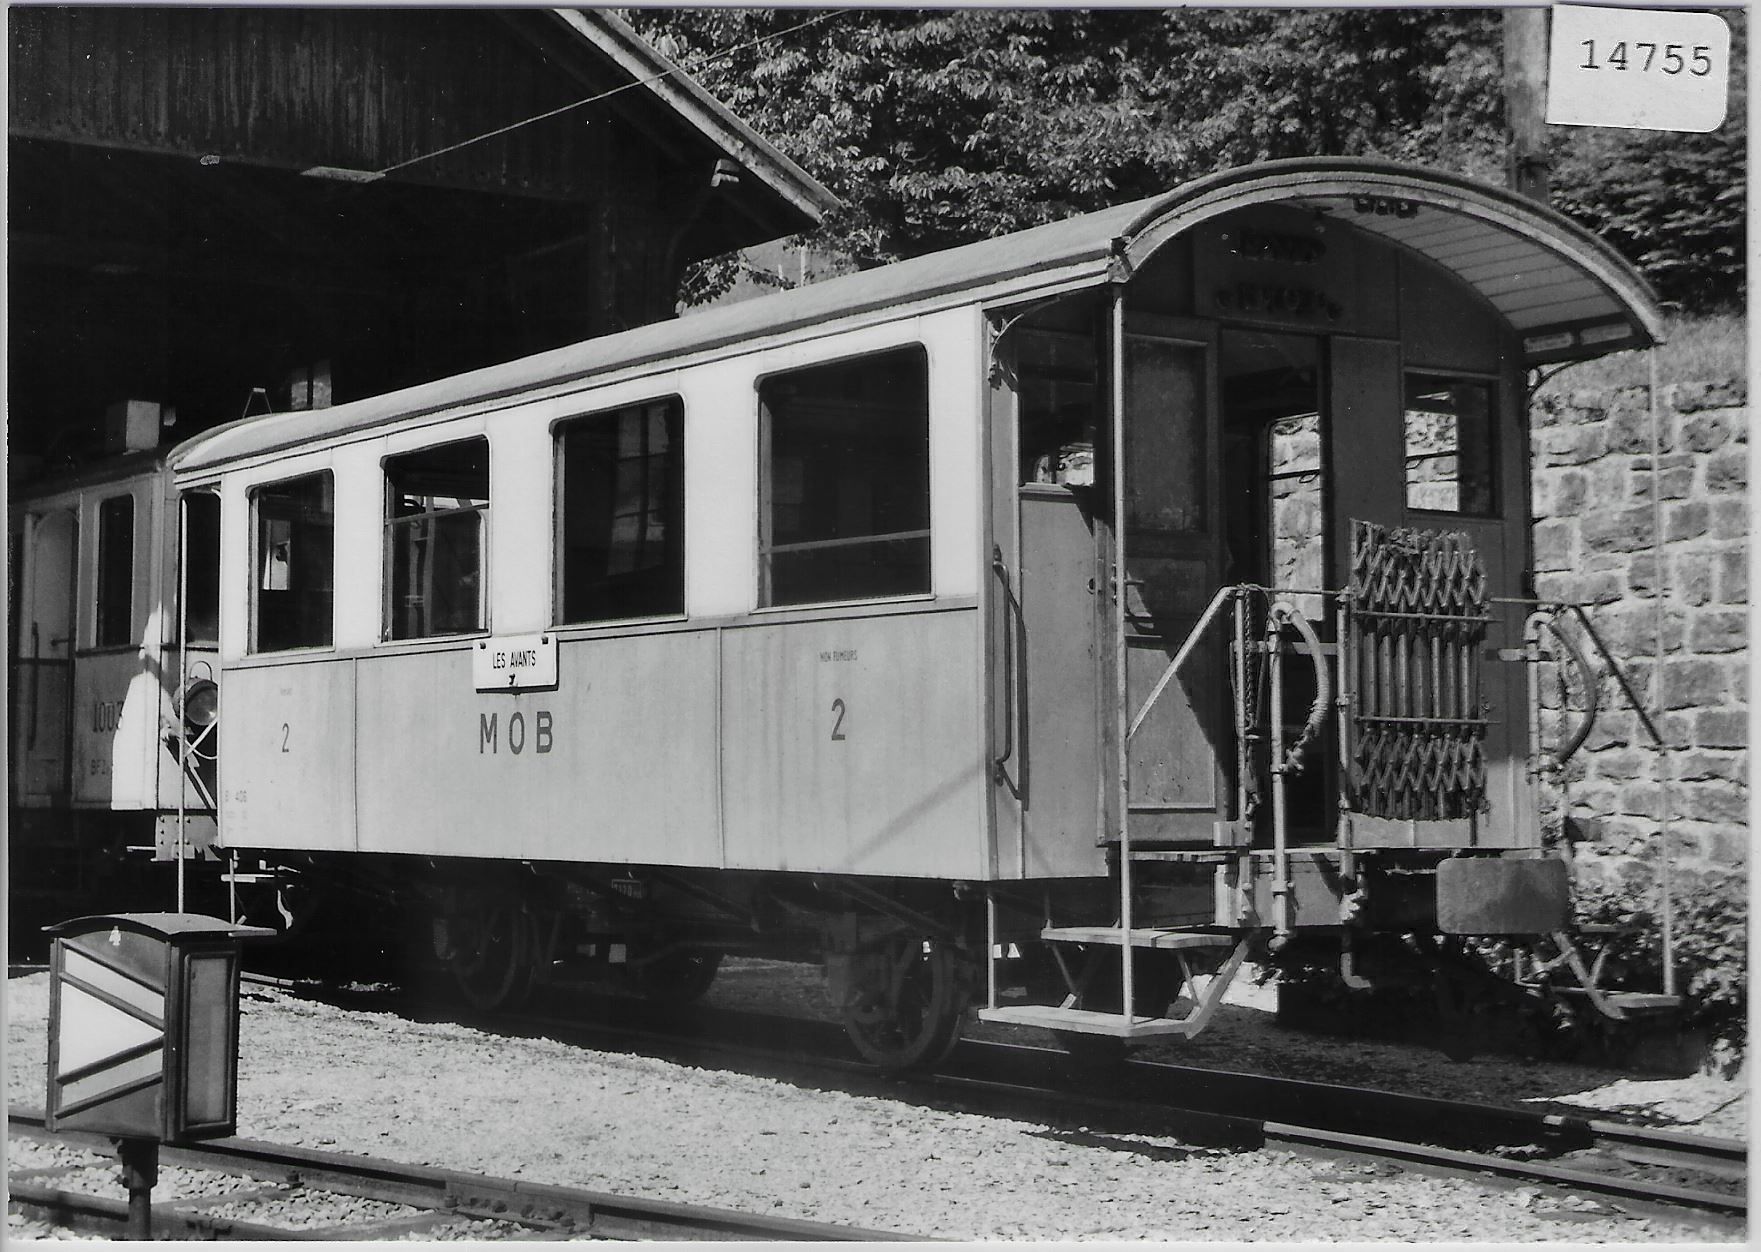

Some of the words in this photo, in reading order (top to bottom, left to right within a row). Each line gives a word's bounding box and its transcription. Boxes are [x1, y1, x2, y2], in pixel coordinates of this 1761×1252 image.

[1580, 40, 1711, 76] 14755
[493, 652, 506, 669] LES
[510, 650, 536, 667] AVANTS
[480, 711, 553, 755] MOB
[832, 698, 846, 740] 2
[281, 723, 290, 752] 2
